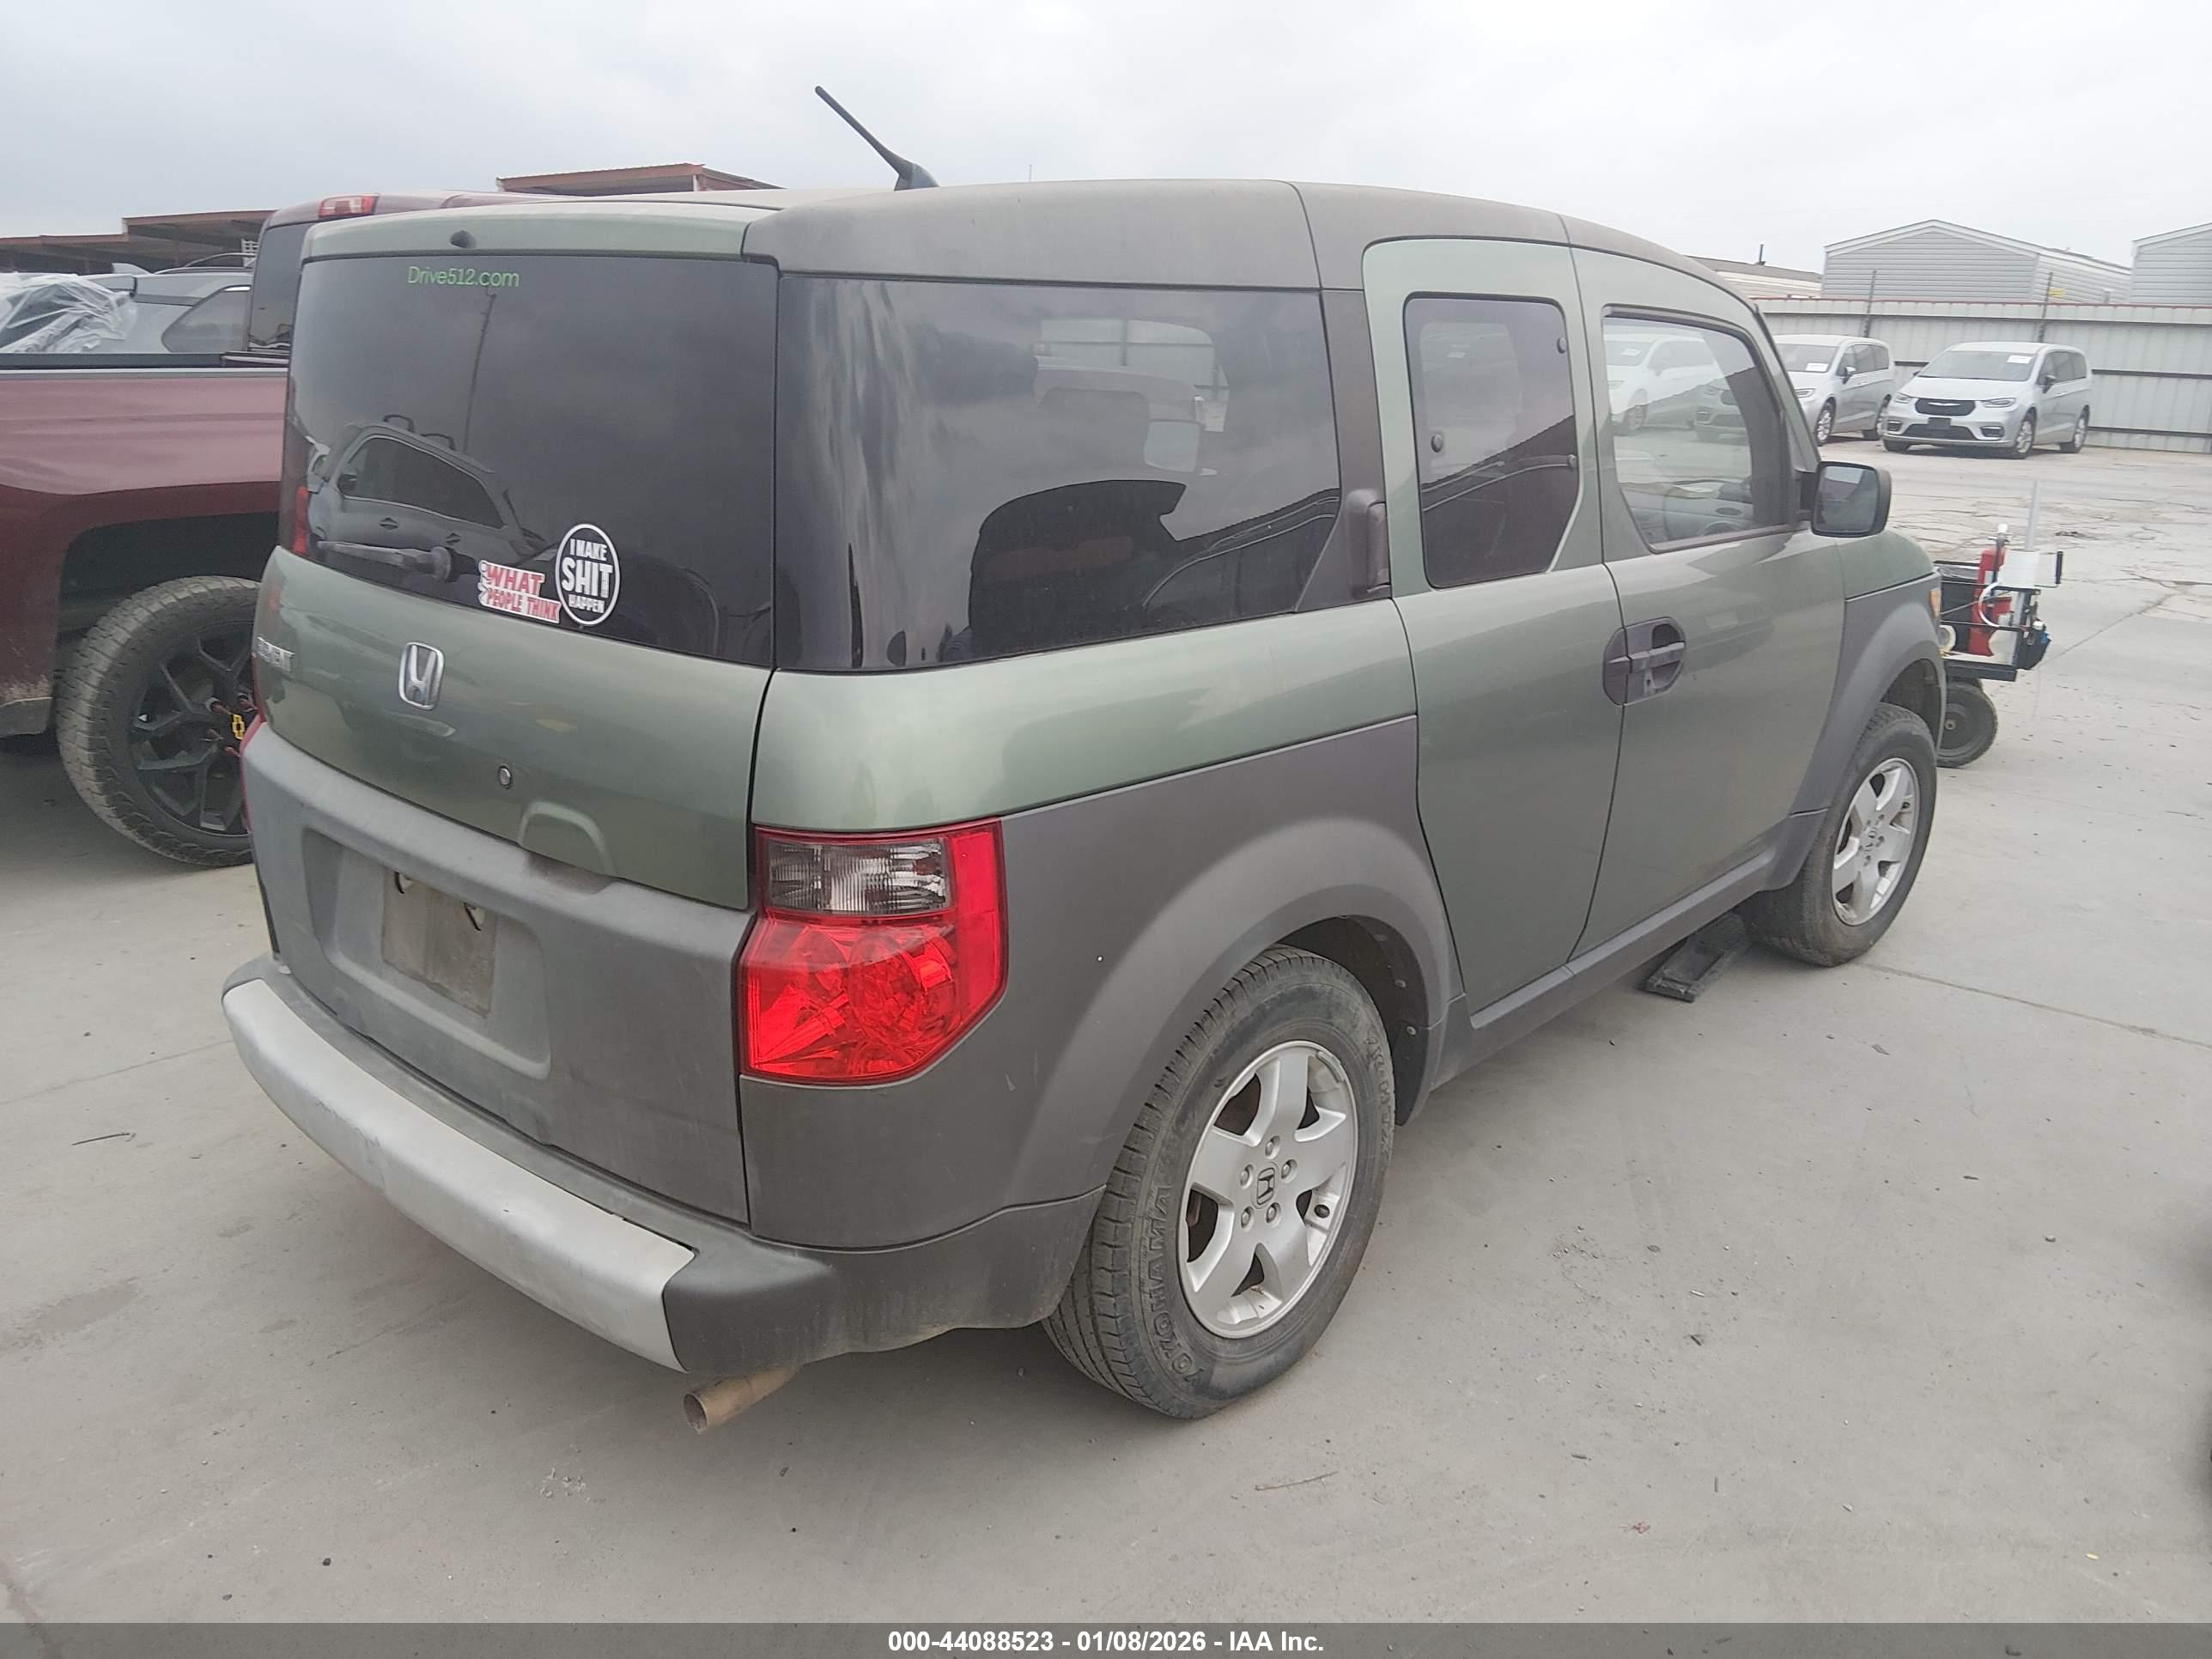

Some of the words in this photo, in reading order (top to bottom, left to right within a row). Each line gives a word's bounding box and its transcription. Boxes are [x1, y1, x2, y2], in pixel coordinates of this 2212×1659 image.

[407, 265, 520, 288] Drive512.com
[576, 539, 607, 562] MAKE
[487, 563, 543, 597] WHAT
[562, 556, 613, 599] SHIT
[487, 589, 523, 611] PEOPLE
[527, 599, 559, 620] THINK
[568, 594, 605, 613] HAPPEN
[1143, 1183, 1205, 1388] YOKOHAMA
